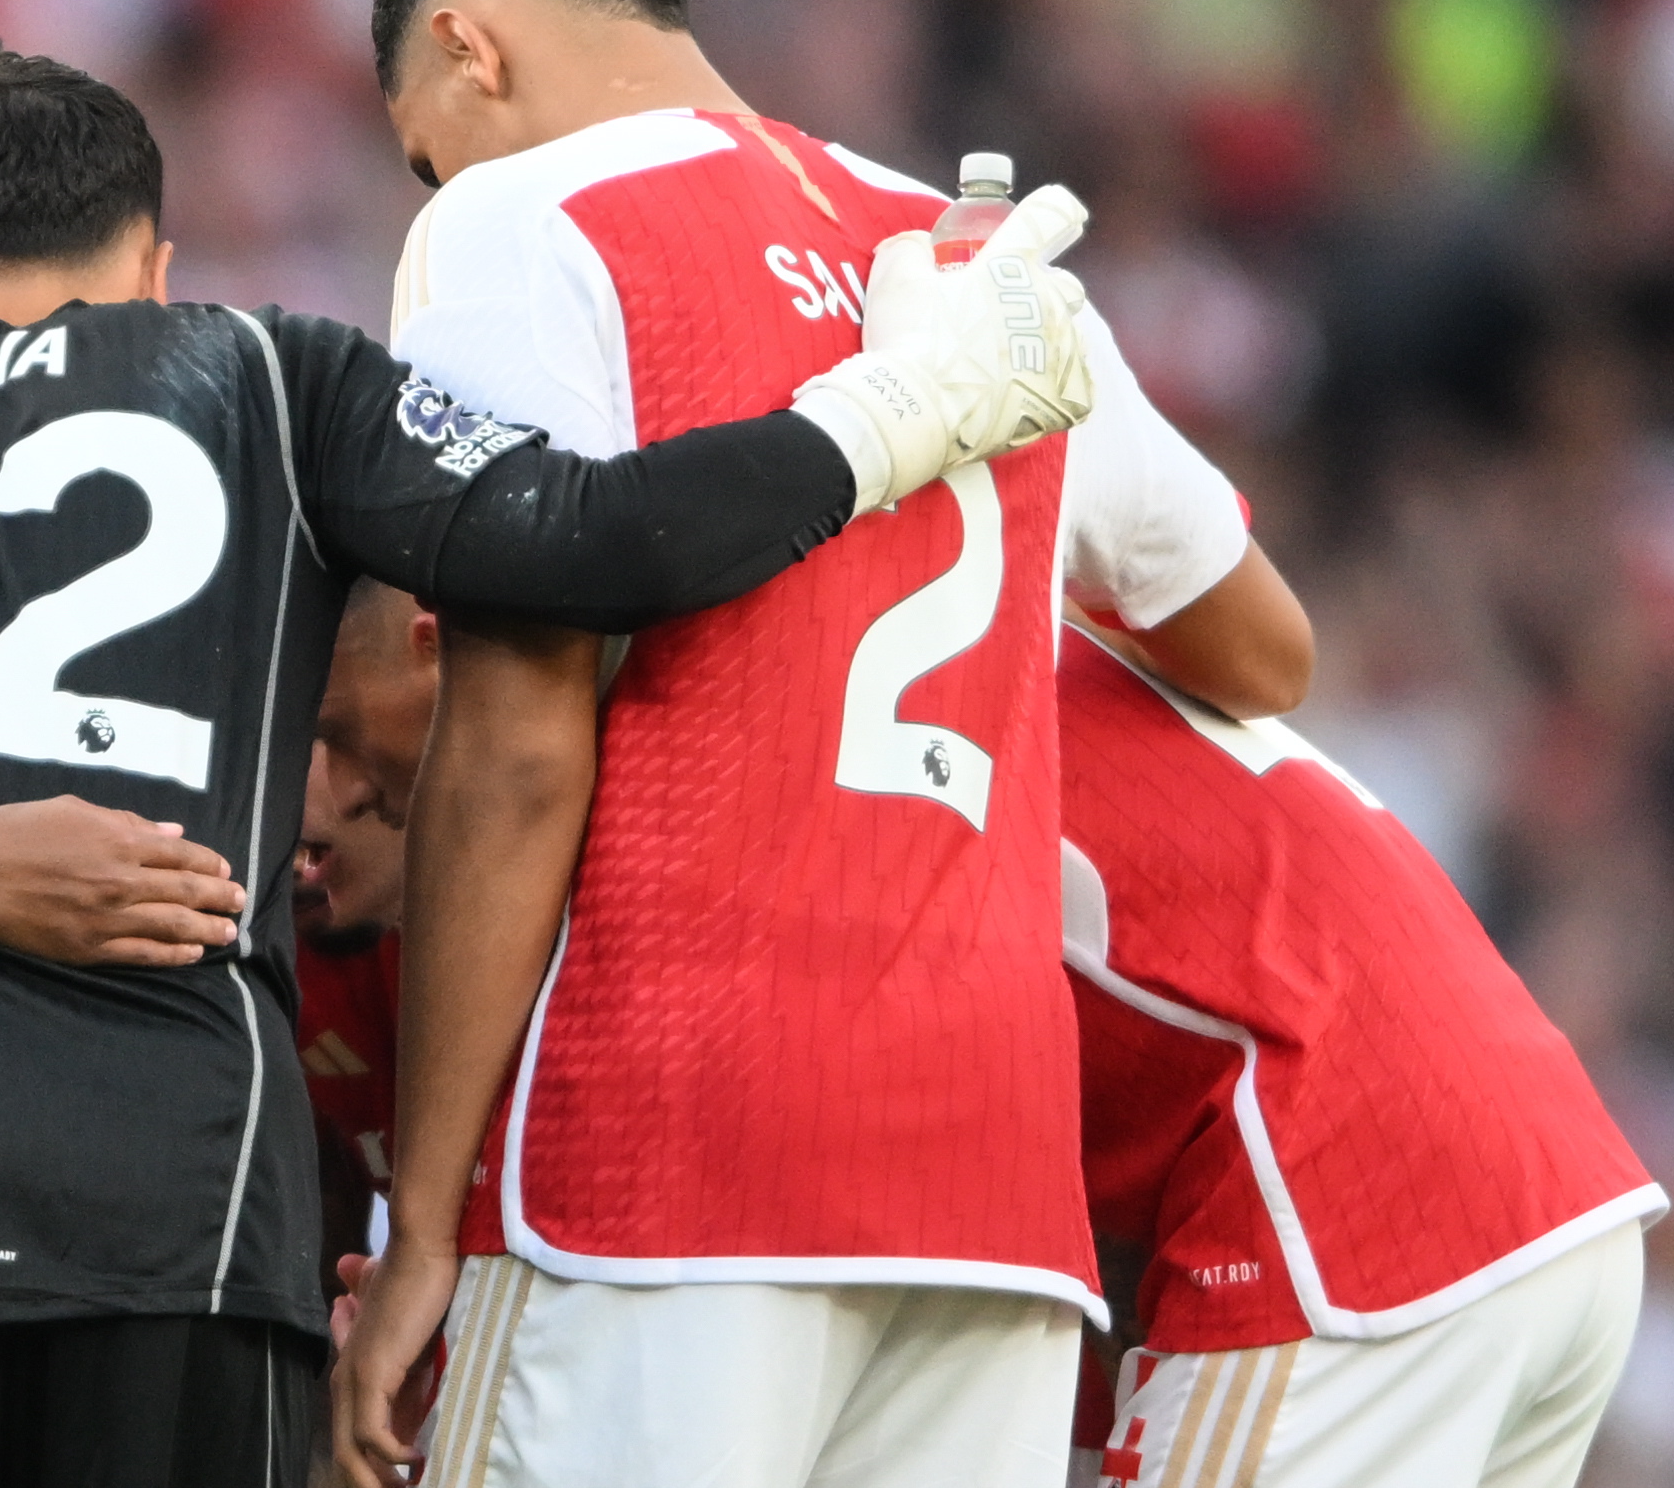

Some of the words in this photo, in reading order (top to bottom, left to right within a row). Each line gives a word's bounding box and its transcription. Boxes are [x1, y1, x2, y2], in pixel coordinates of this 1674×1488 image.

[862, 375, 905, 420] RAYA
[874, 366, 922, 417] DAVID
[434, 440, 474, 470] No
